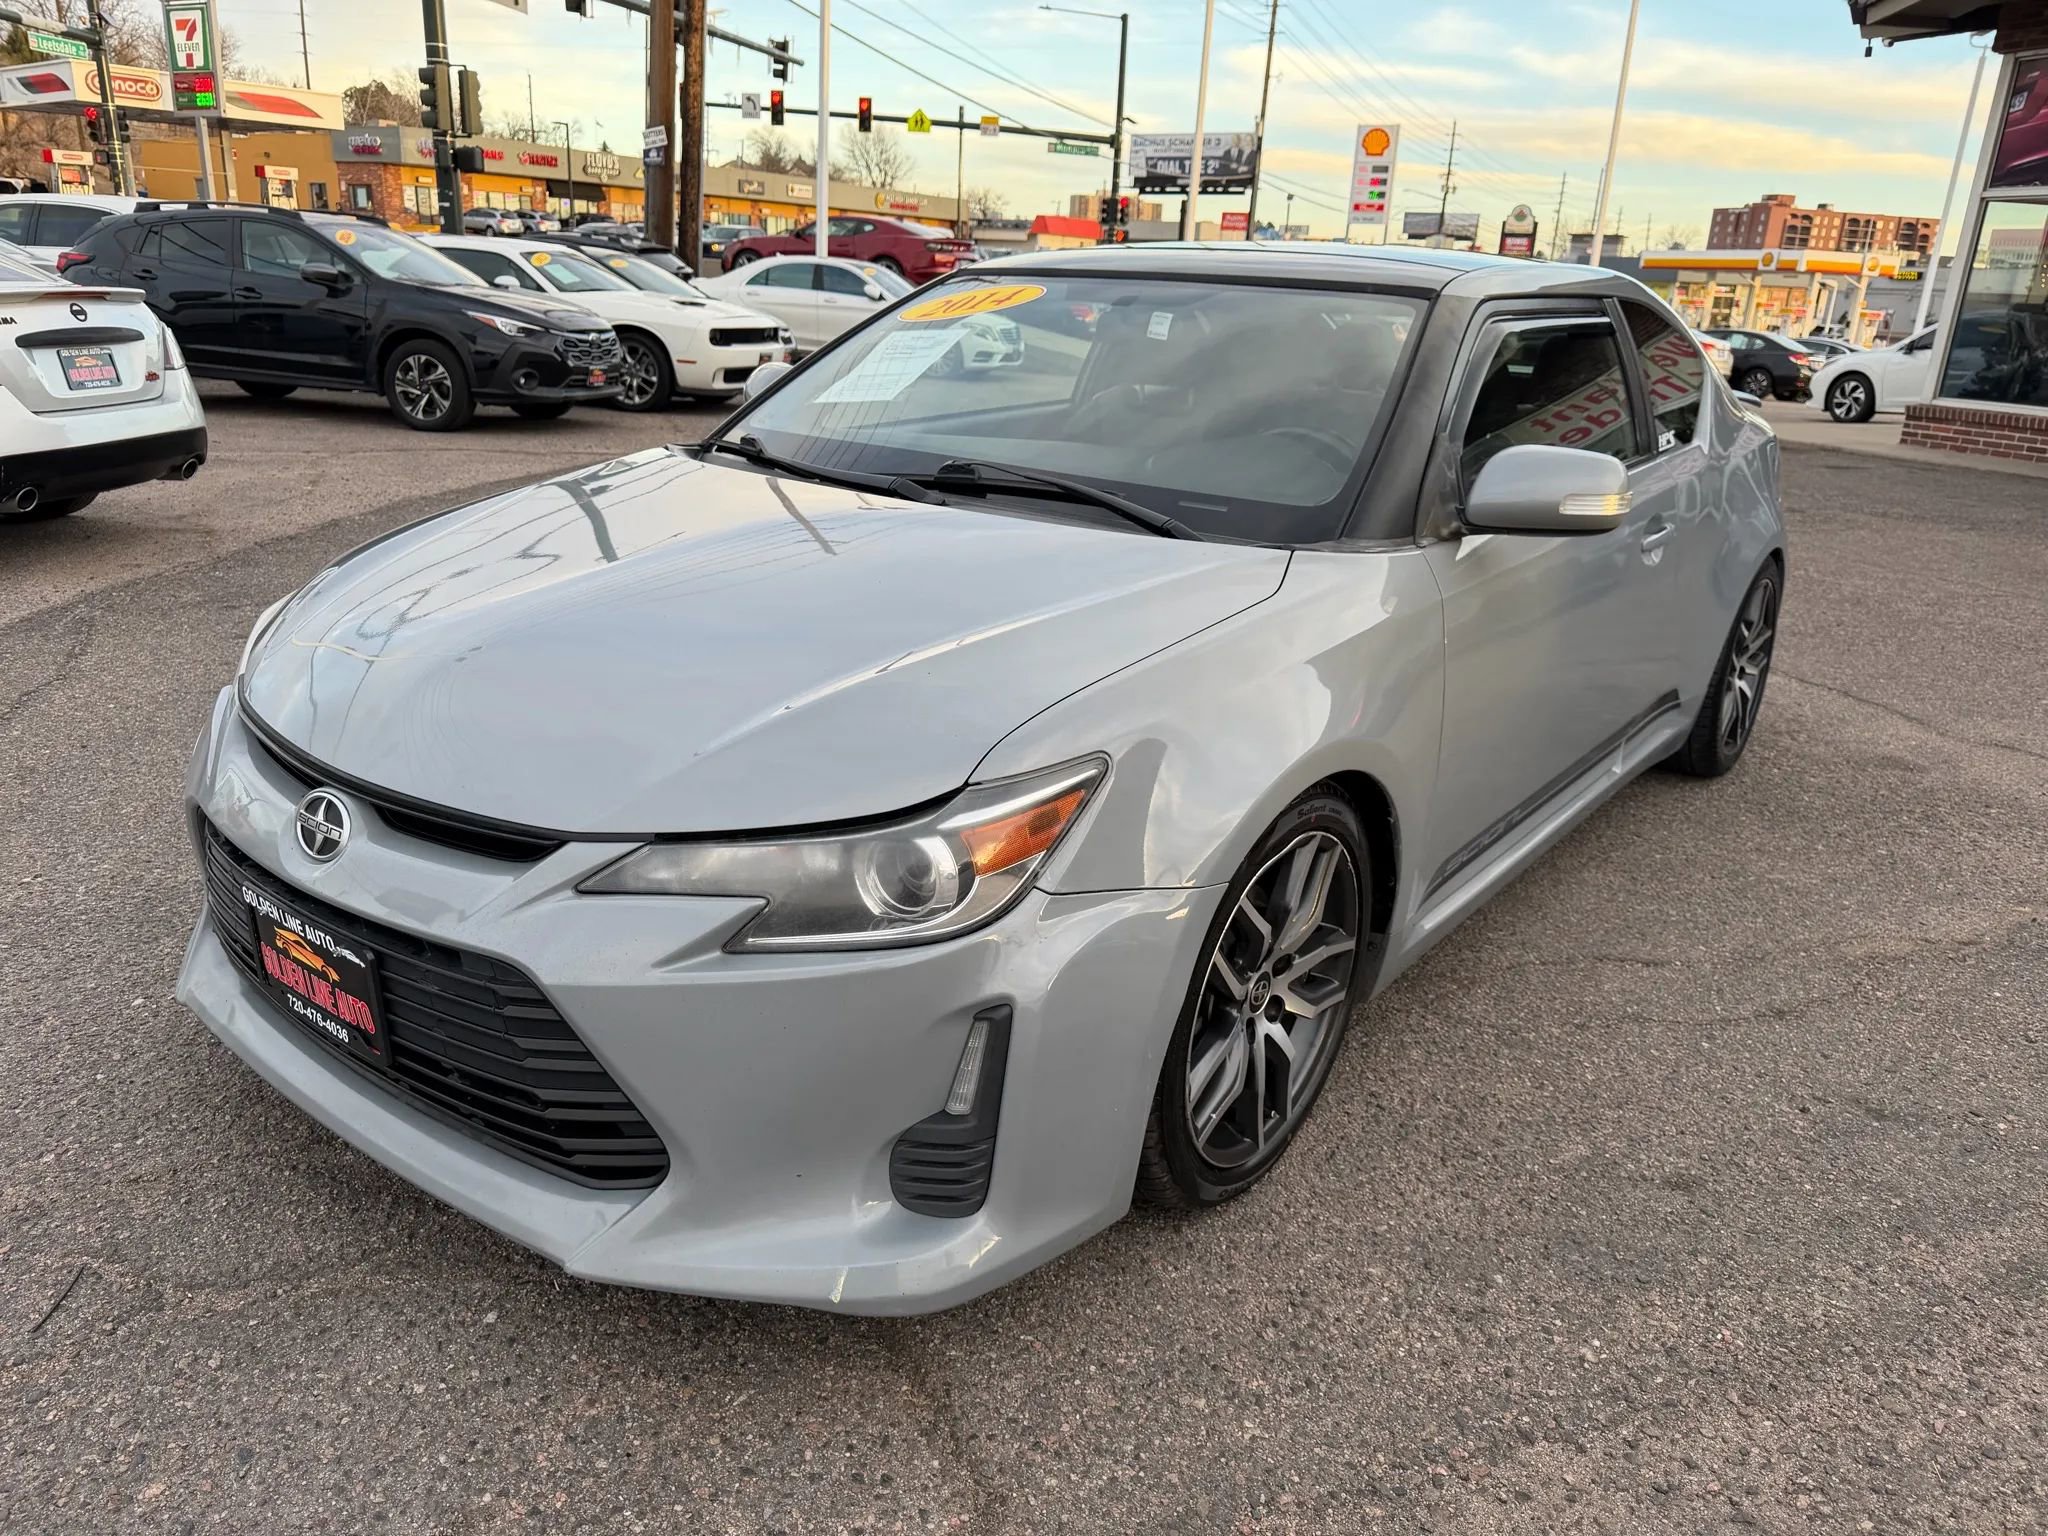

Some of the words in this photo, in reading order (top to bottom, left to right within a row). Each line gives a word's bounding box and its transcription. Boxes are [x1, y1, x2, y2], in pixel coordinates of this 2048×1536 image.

[38, 37, 77, 56] Leetsdale
[177, 43, 200, 52] ELEVEN
[92, 74, 158, 95] noco
[1183, 160, 1206, 174] TE
[920, 289, 1027, 318] 2014
[242, 886, 280, 923] GOLDEN
[279, 909, 305, 937] LINE
[305, 924, 335, 952] AUTO
[260, 941, 309, 999] GOLDEN
[303, 969, 338, 1015] LINE
[335, 987, 376, 1035] AUTO
[287, 993, 349, 1043] 720-476-4036
